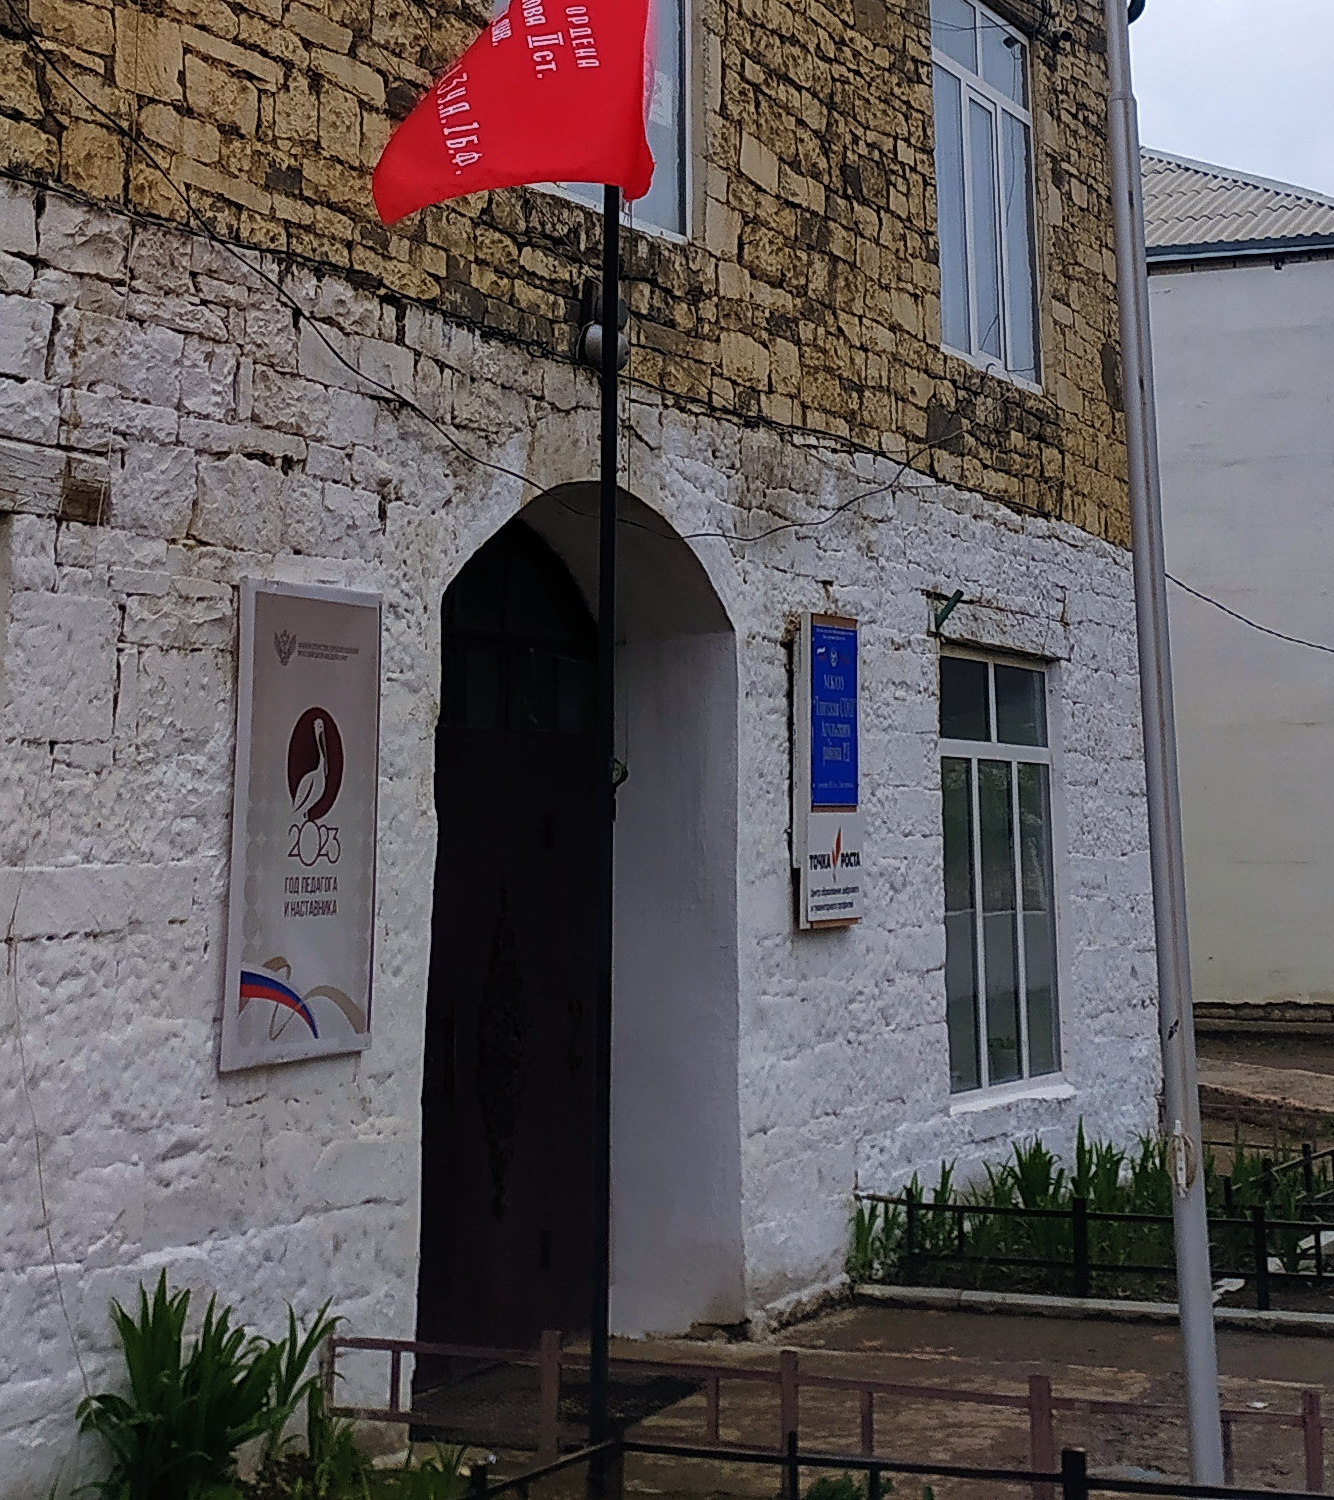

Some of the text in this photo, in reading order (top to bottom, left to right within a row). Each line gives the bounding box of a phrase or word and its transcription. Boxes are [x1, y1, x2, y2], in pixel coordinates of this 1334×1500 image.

[565, 5, 600, 68] ОРДЕНА
[287, 819, 341, 867] 2023
[809, 851, 861, 871] ТОЧКА РОСТА
[284, 876, 338, 896] ГОД ПЕДАГОГА
[283, 899, 338, 918] И НАСТАВНИКА
